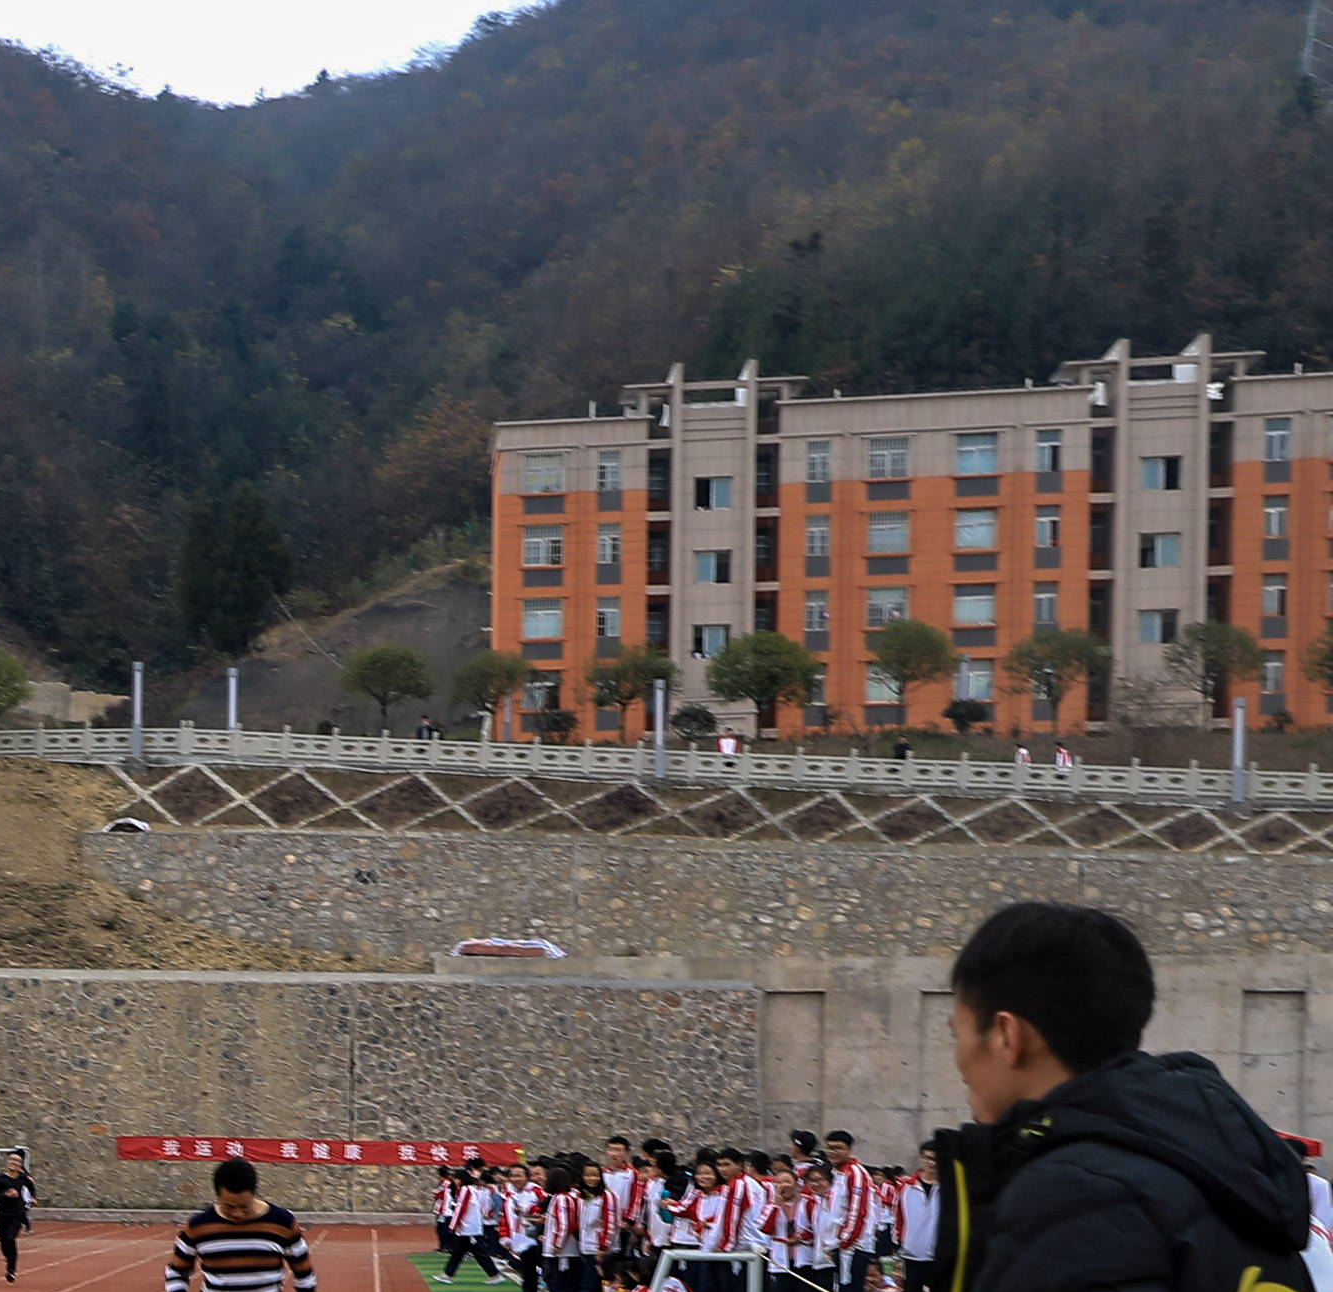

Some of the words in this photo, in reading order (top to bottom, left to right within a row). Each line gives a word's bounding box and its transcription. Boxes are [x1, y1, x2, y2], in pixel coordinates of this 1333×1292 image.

[161, 1139, 244, 1158] 我运动
[279, 1142, 363, 1160] 我健康
[397, 1144, 481, 1162] 我快乐
